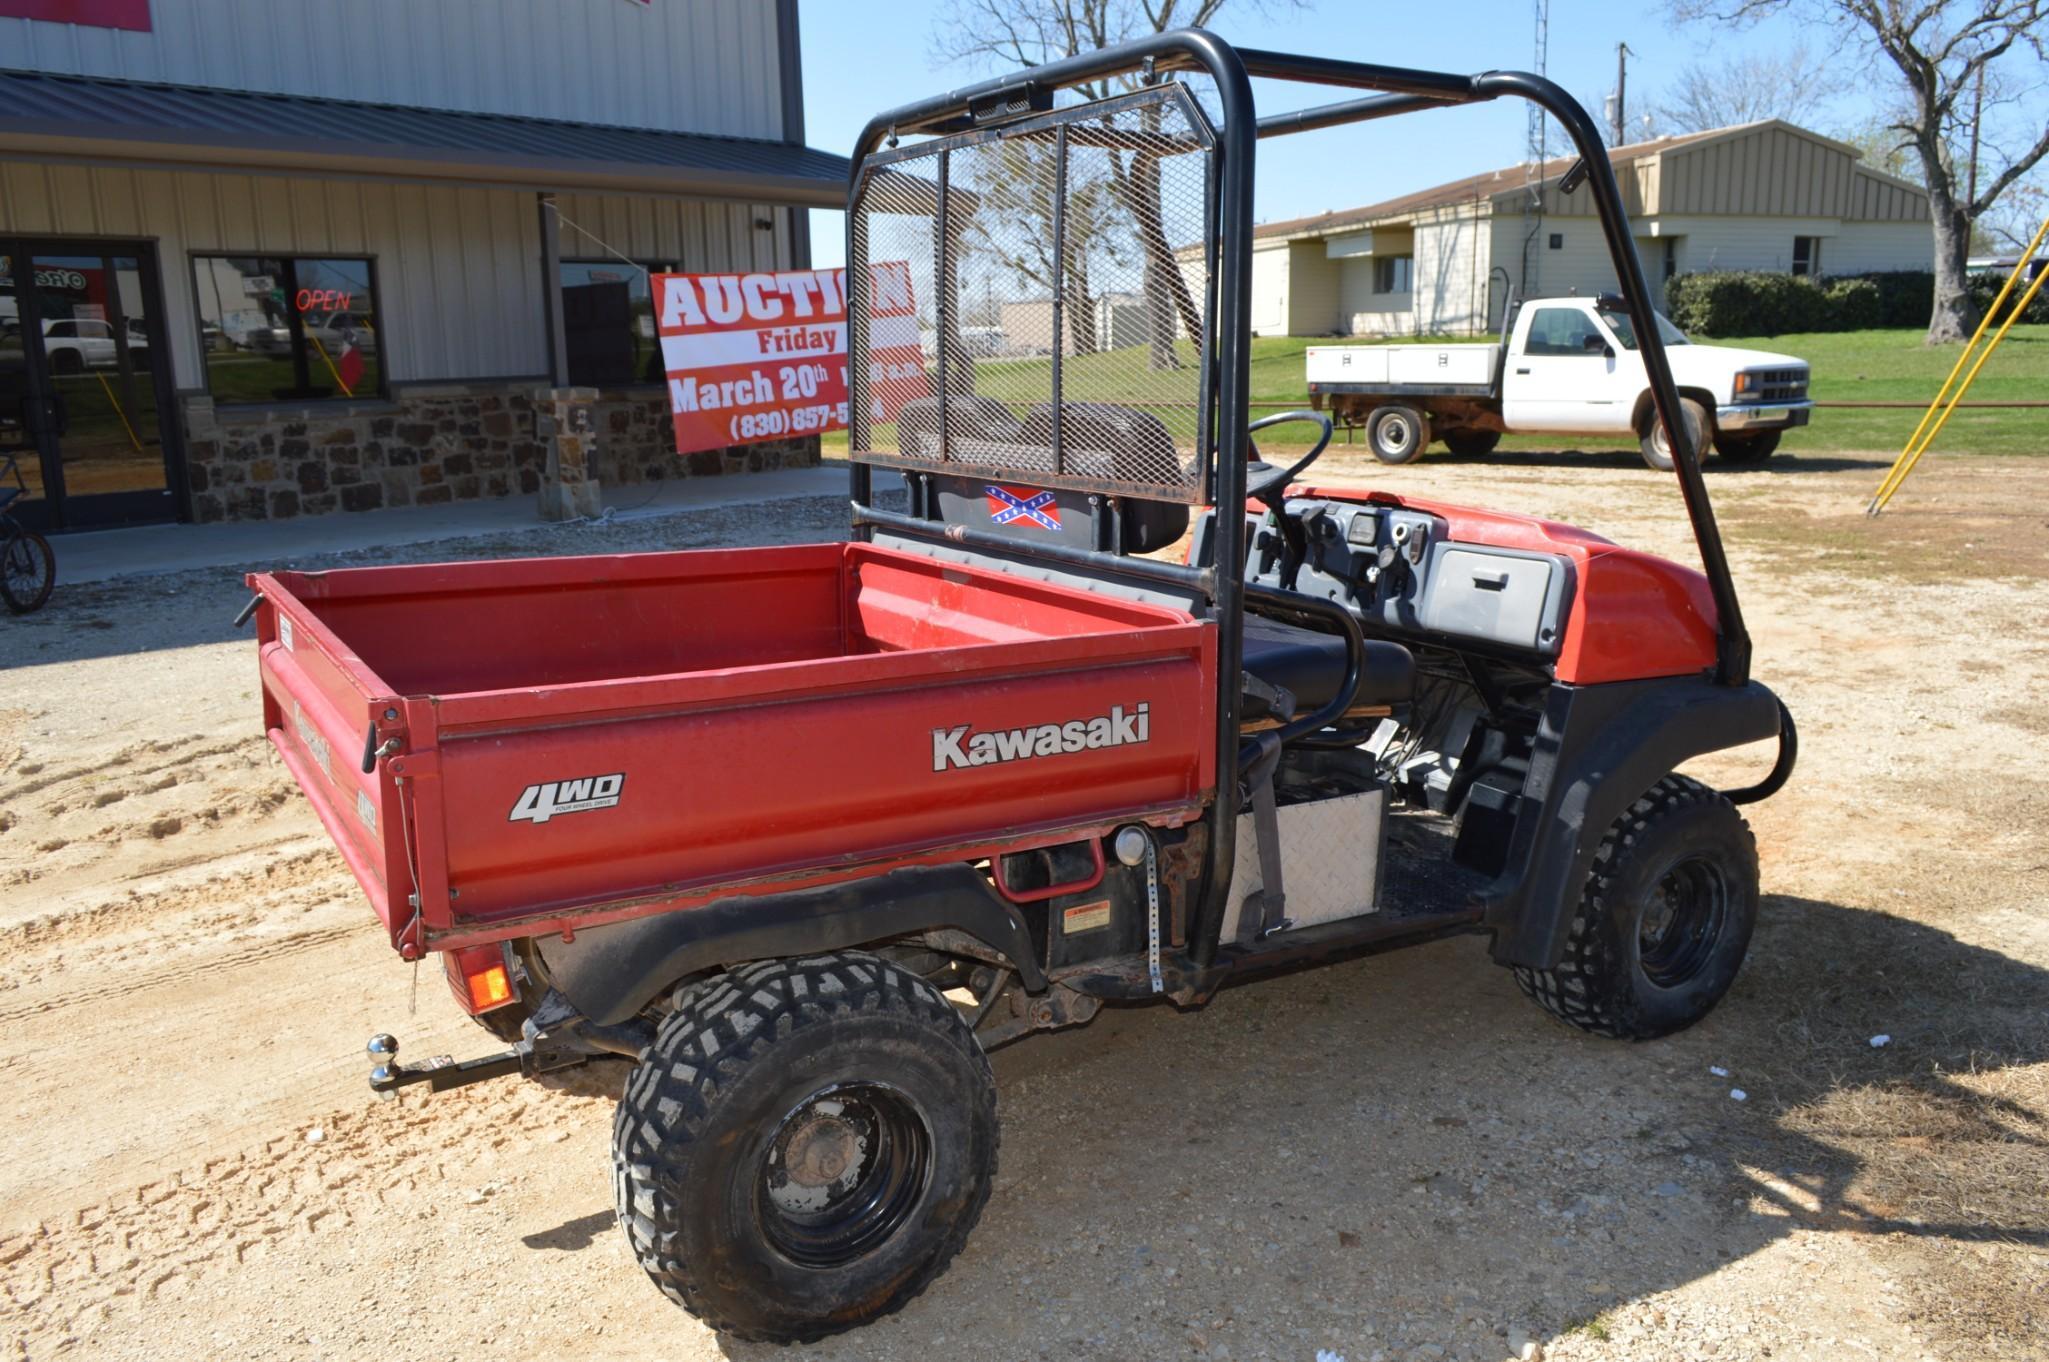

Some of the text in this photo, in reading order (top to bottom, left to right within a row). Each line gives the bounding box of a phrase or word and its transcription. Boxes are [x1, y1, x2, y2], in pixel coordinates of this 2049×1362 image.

[296, 288, 352, 312] OPEN
[662, 267, 910, 327] AUCTIN
[757, 326, 836, 354] Friday
[670, 369, 775, 414] March
[779, 363, 829, 400] 20th
[933, 702, 1150, 772] Kawasaki
[509, 773, 623, 824] 4WD
[555, 798, 612, 812] FOUR WHEEL DRIVE
